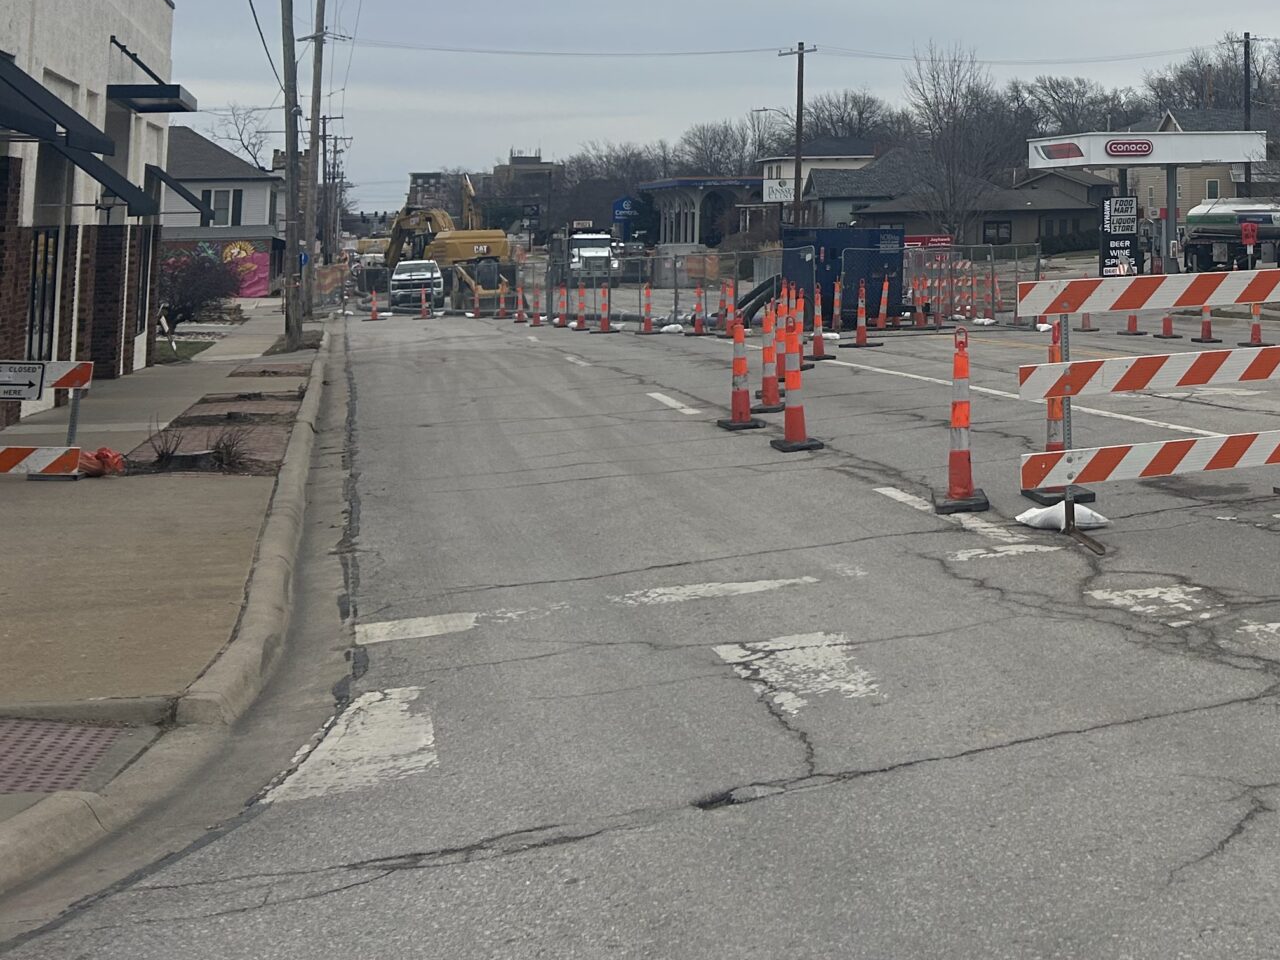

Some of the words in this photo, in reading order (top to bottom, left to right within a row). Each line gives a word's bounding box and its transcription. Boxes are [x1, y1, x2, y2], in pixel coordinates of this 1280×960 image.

[1115, 199, 1134, 207] FOOD
[1111, 217, 1136, 225] LIQUOR
[1110, 240, 1131, 248] BEER
[473, 245, 487, 254] CAT
[1109, 249, 1131, 257] WINE
